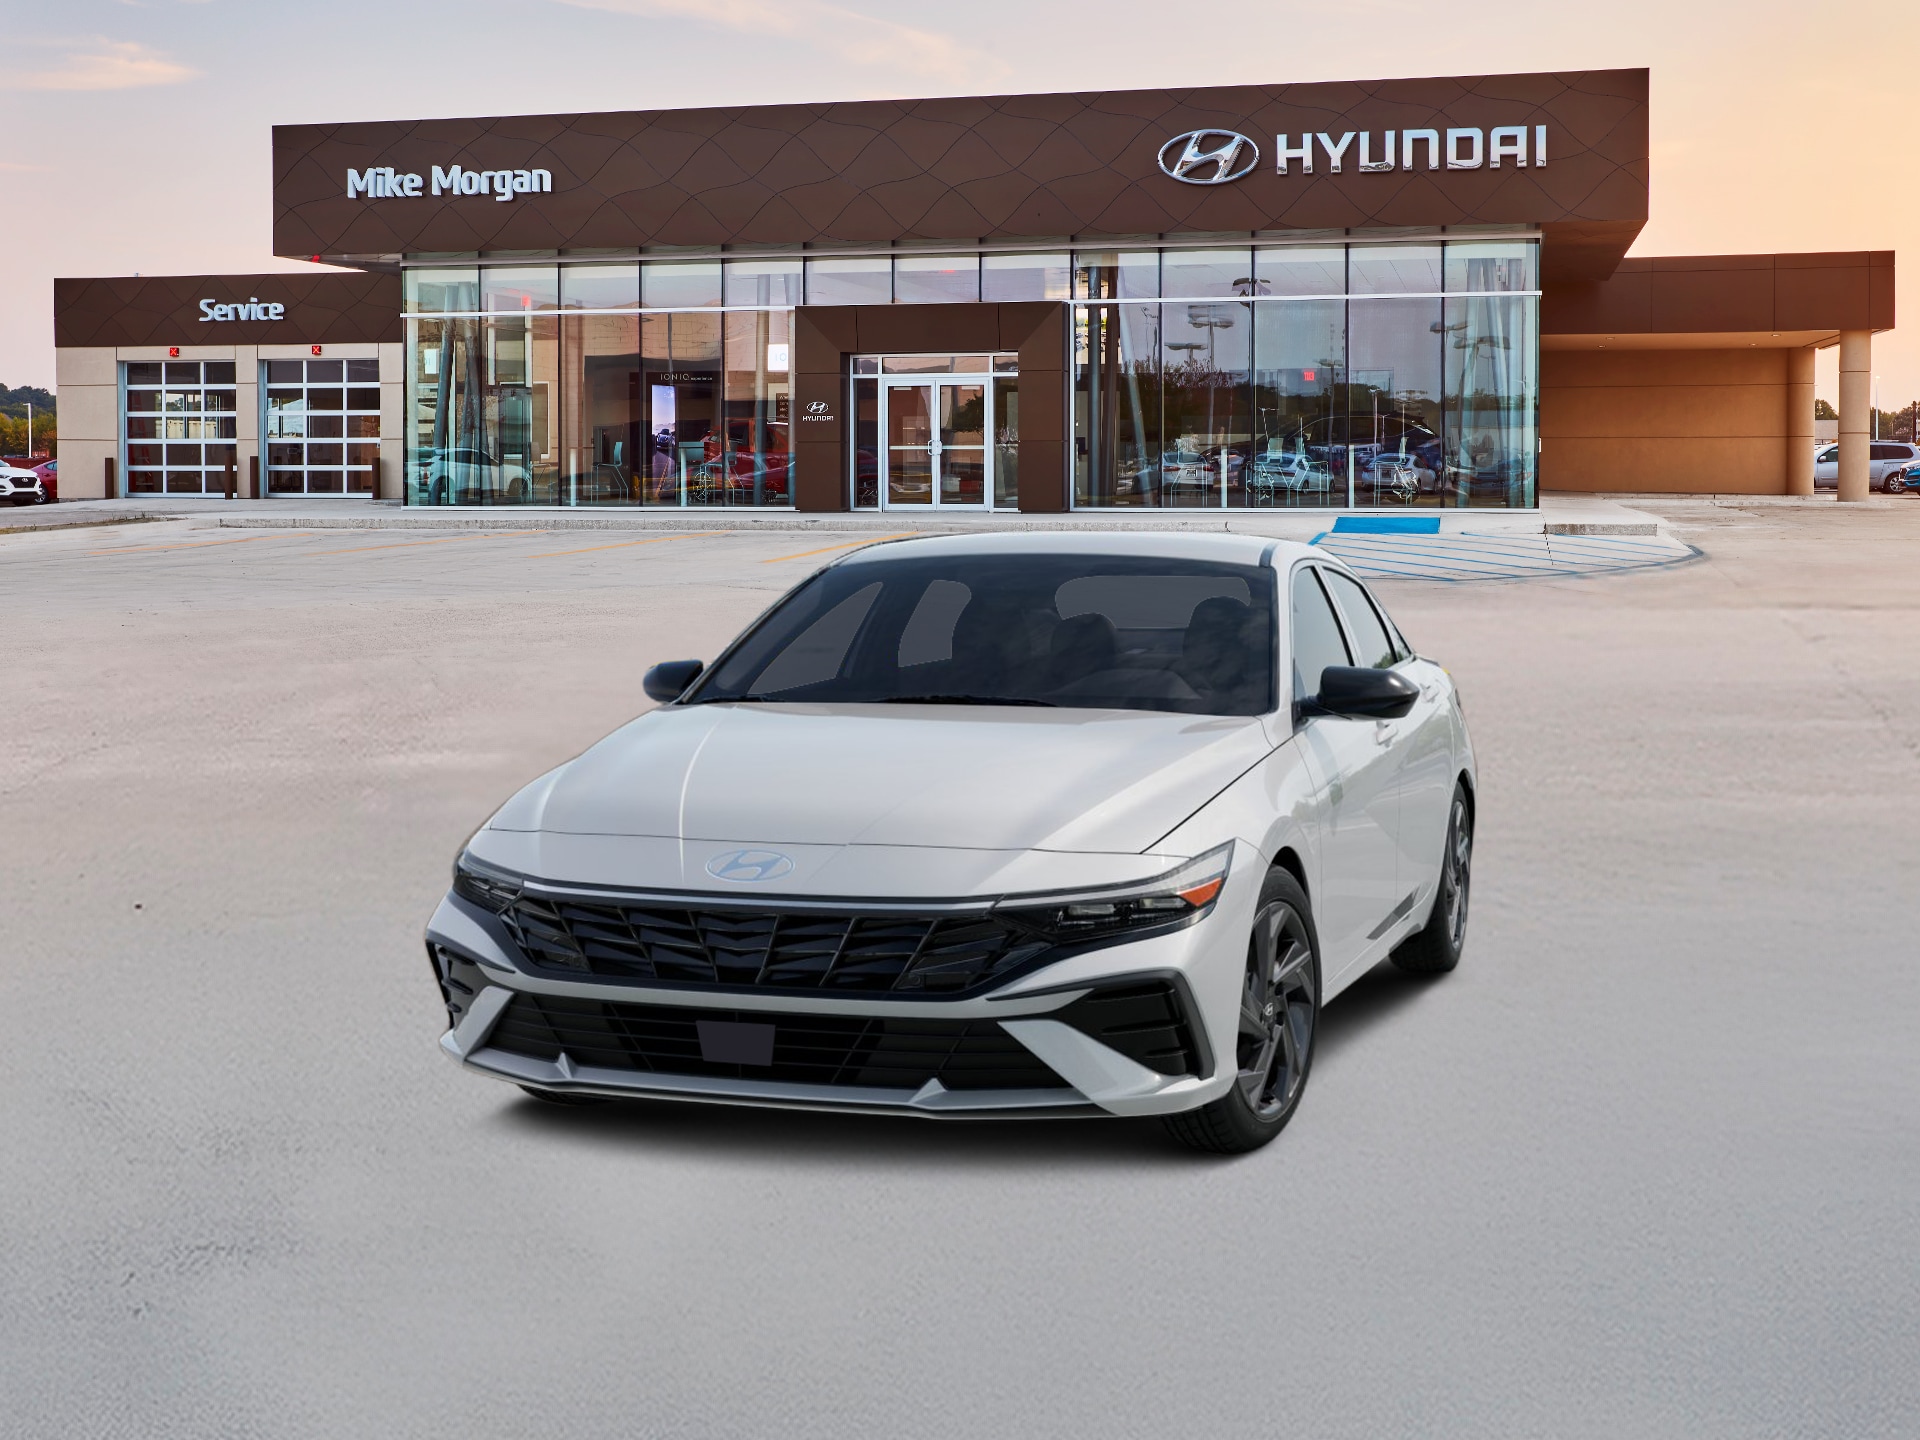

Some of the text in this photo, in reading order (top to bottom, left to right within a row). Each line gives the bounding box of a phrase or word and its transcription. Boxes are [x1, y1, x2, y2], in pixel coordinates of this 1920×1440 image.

[1276, 124, 1548, 176] HYUNDAI
[347, 164, 552, 202] Mike Morgan
[199, 296, 285, 322] Service
